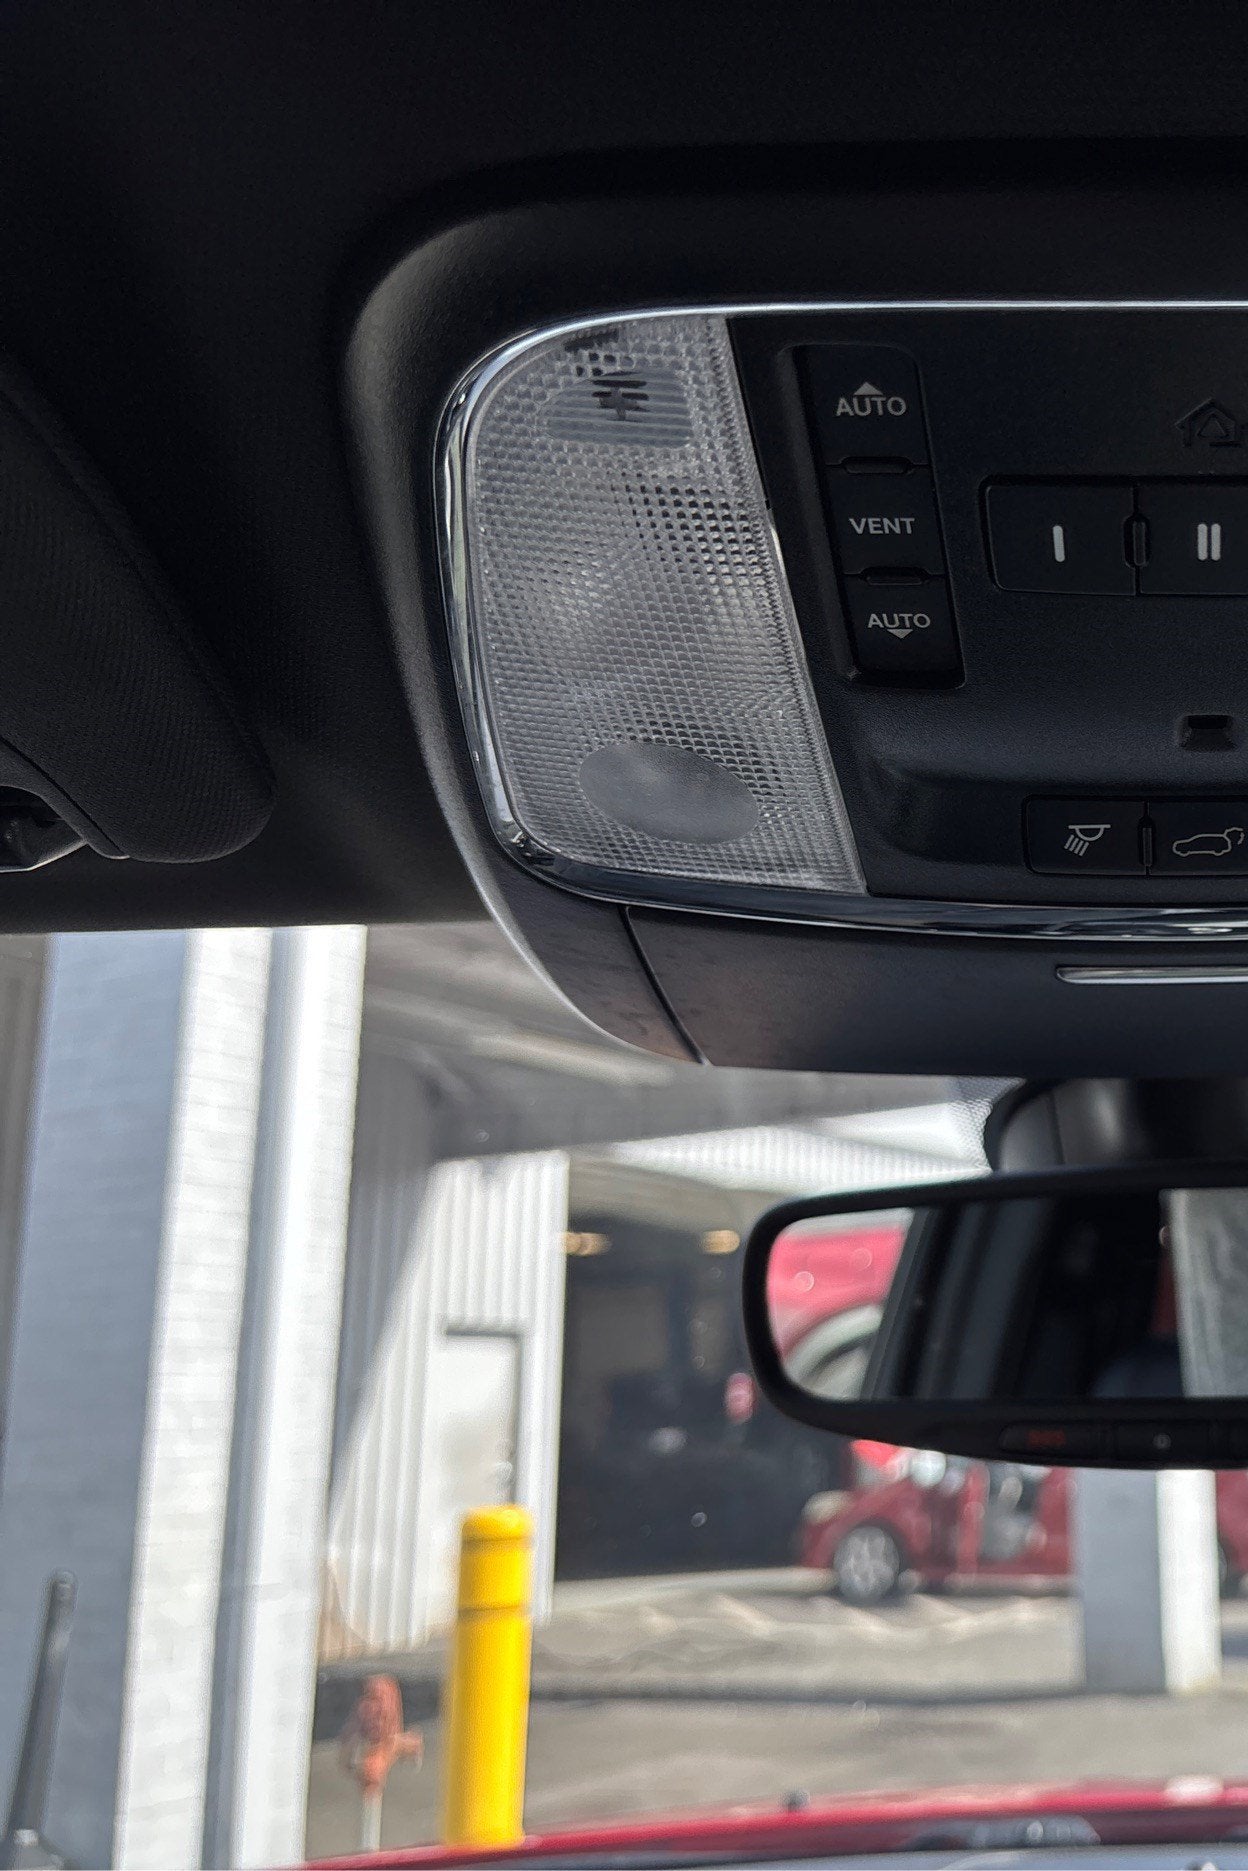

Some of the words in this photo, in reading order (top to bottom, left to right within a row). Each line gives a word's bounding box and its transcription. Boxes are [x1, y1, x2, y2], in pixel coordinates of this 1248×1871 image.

[836, 396, 907, 417] AUTO
[848, 516, 915, 535] VENT
[867, 613, 931, 629] AUTO
